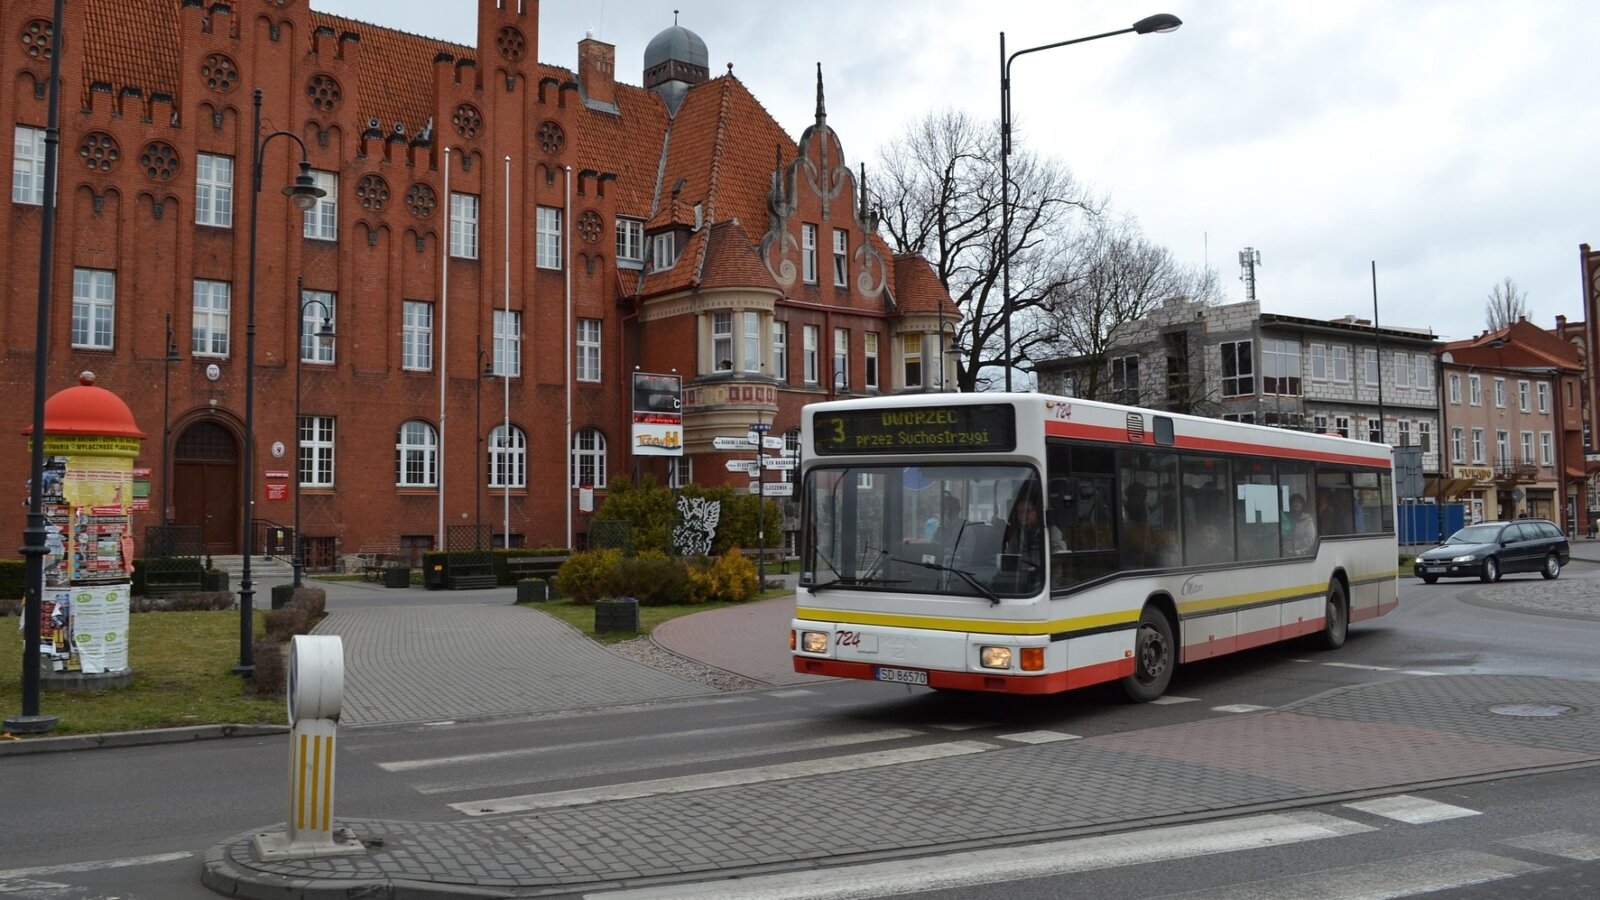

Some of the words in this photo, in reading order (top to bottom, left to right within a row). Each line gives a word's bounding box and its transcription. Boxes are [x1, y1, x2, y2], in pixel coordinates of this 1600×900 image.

[882, 410, 958, 426] DWORZEC
[1056, 403, 1071, 419] 724
[831, 418, 846, 443] 3
[856, 433, 893, 447] przez
[899, 428, 989, 445] Suchostrzygi
[835, 630, 861, 647] 724
[881, 668, 894, 680] SD
[897, 670, 926, 683] 86570
